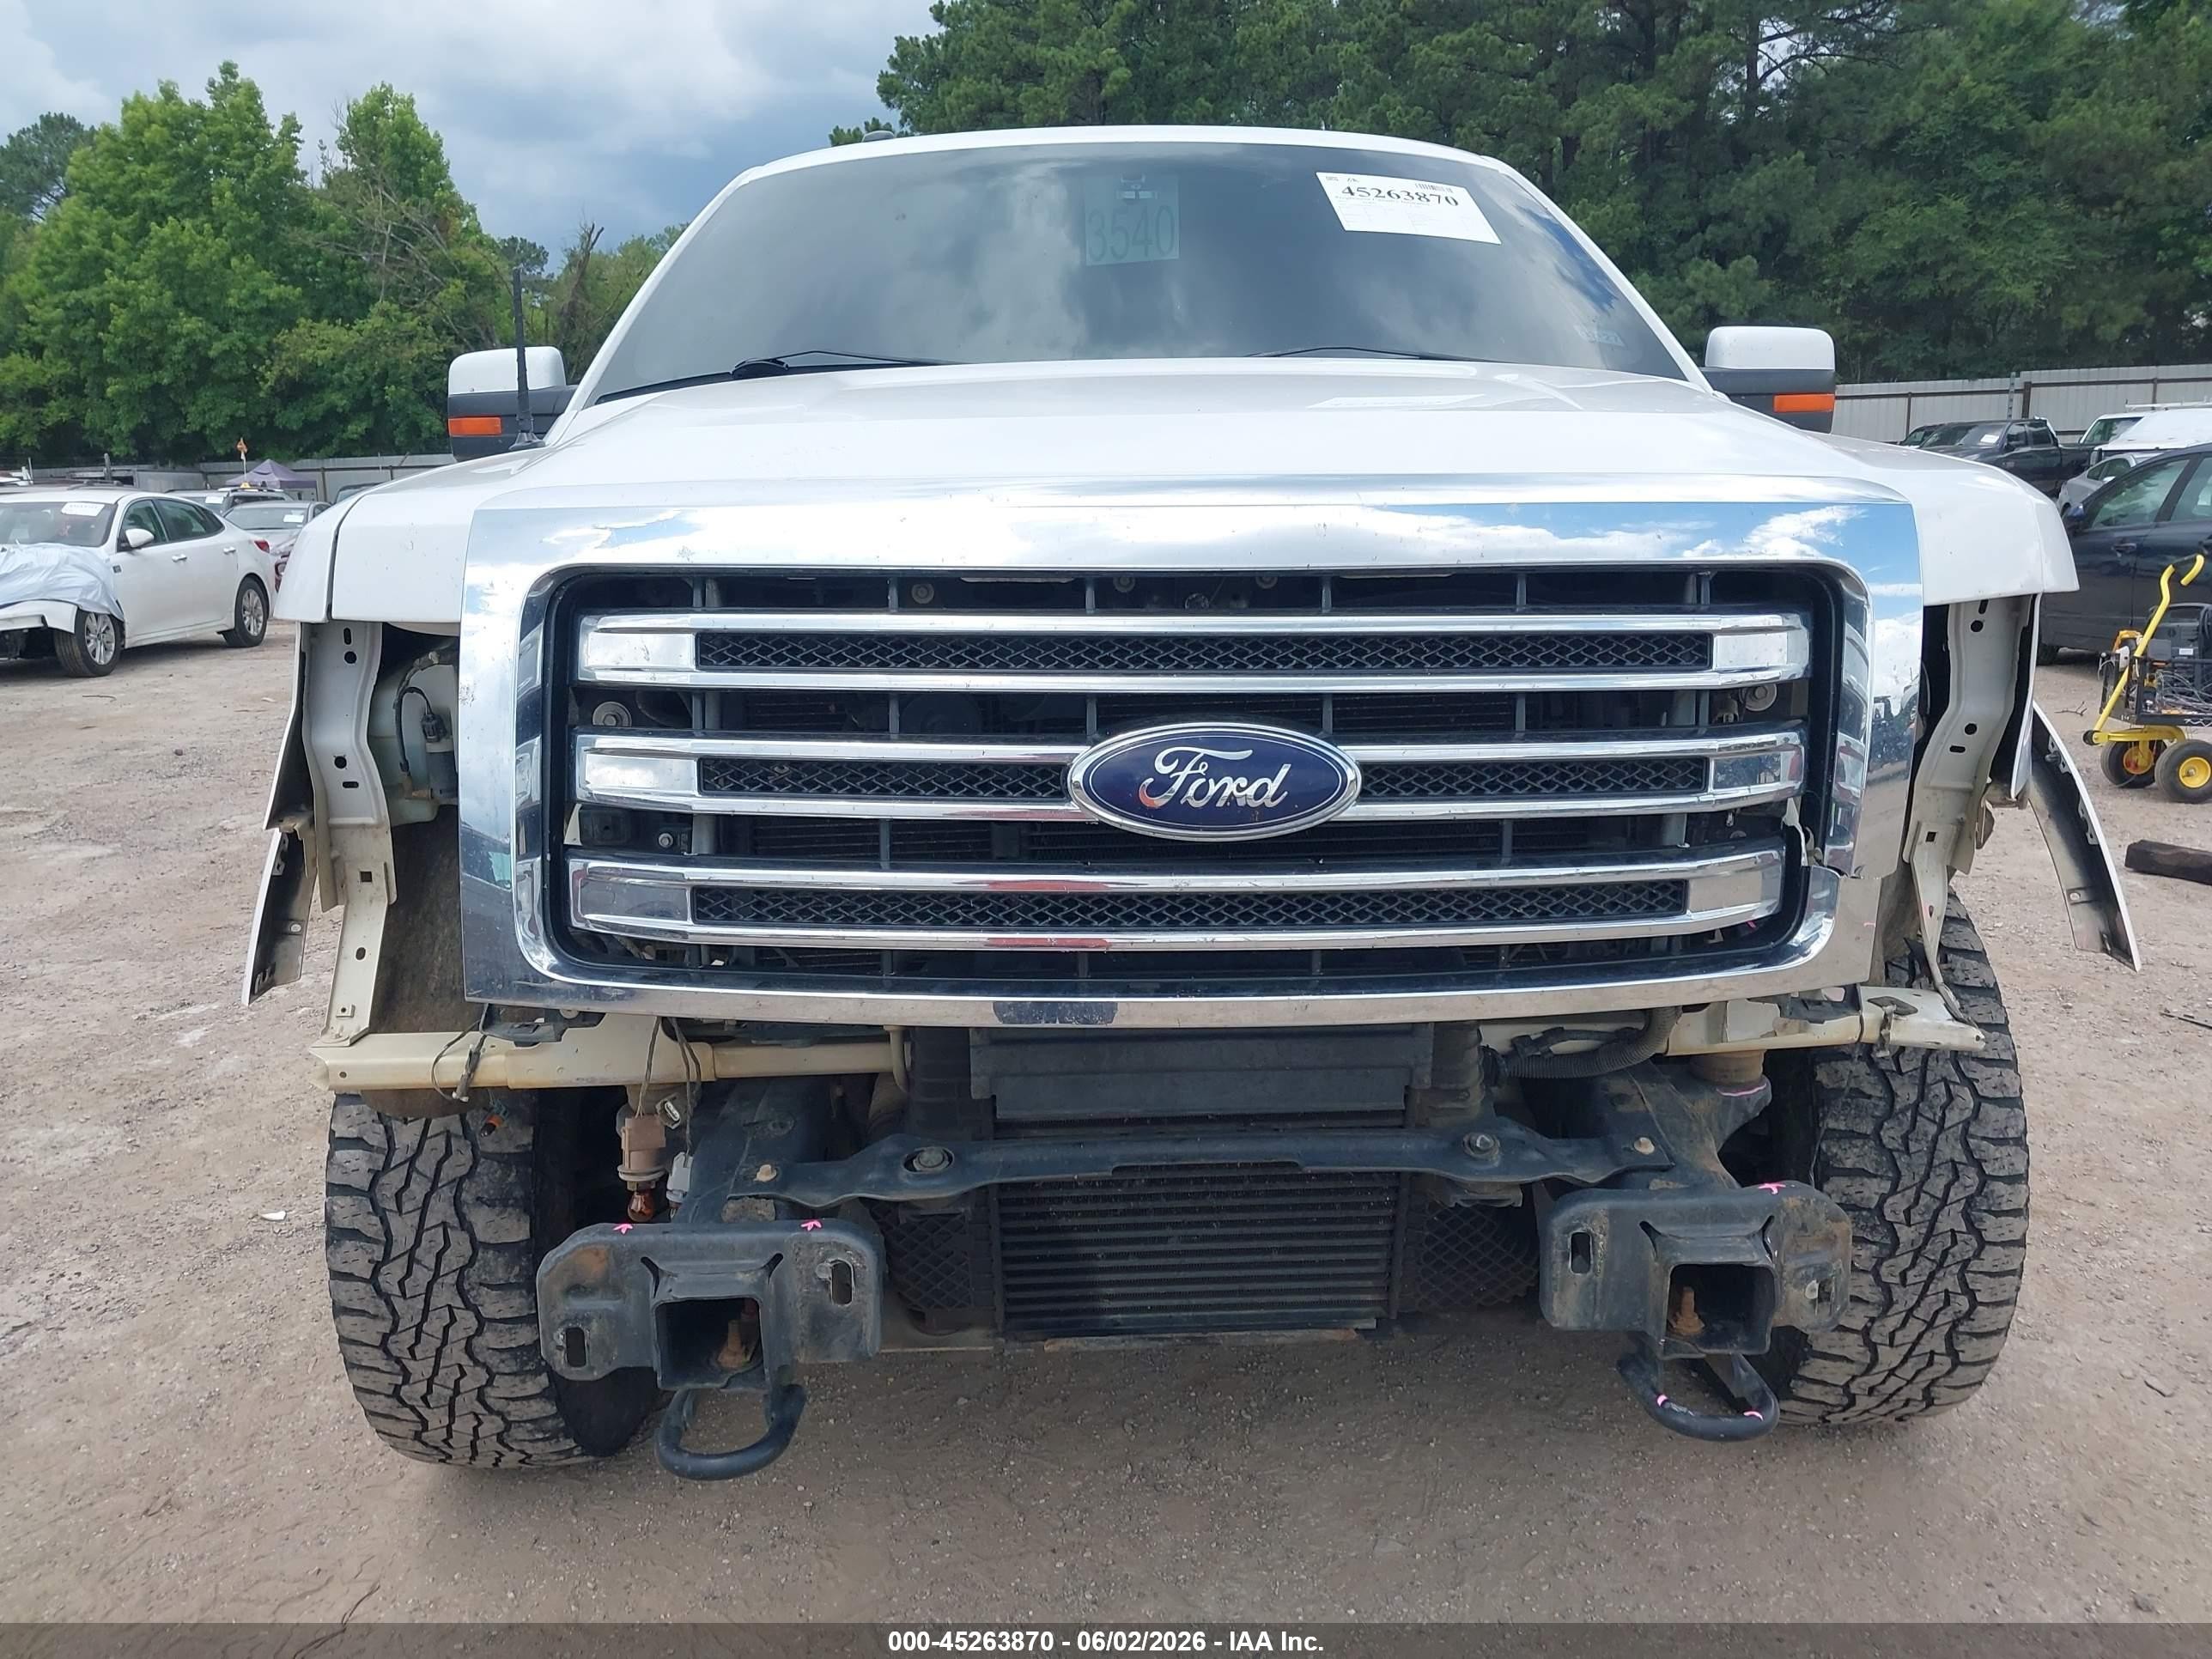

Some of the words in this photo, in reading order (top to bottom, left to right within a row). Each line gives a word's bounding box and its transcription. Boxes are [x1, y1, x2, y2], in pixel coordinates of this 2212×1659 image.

[1341, 185, 1459, 207] 45263870
[1088, 205, 1175, 263] 3540
[1139, 746, 1291, 808] Ford
